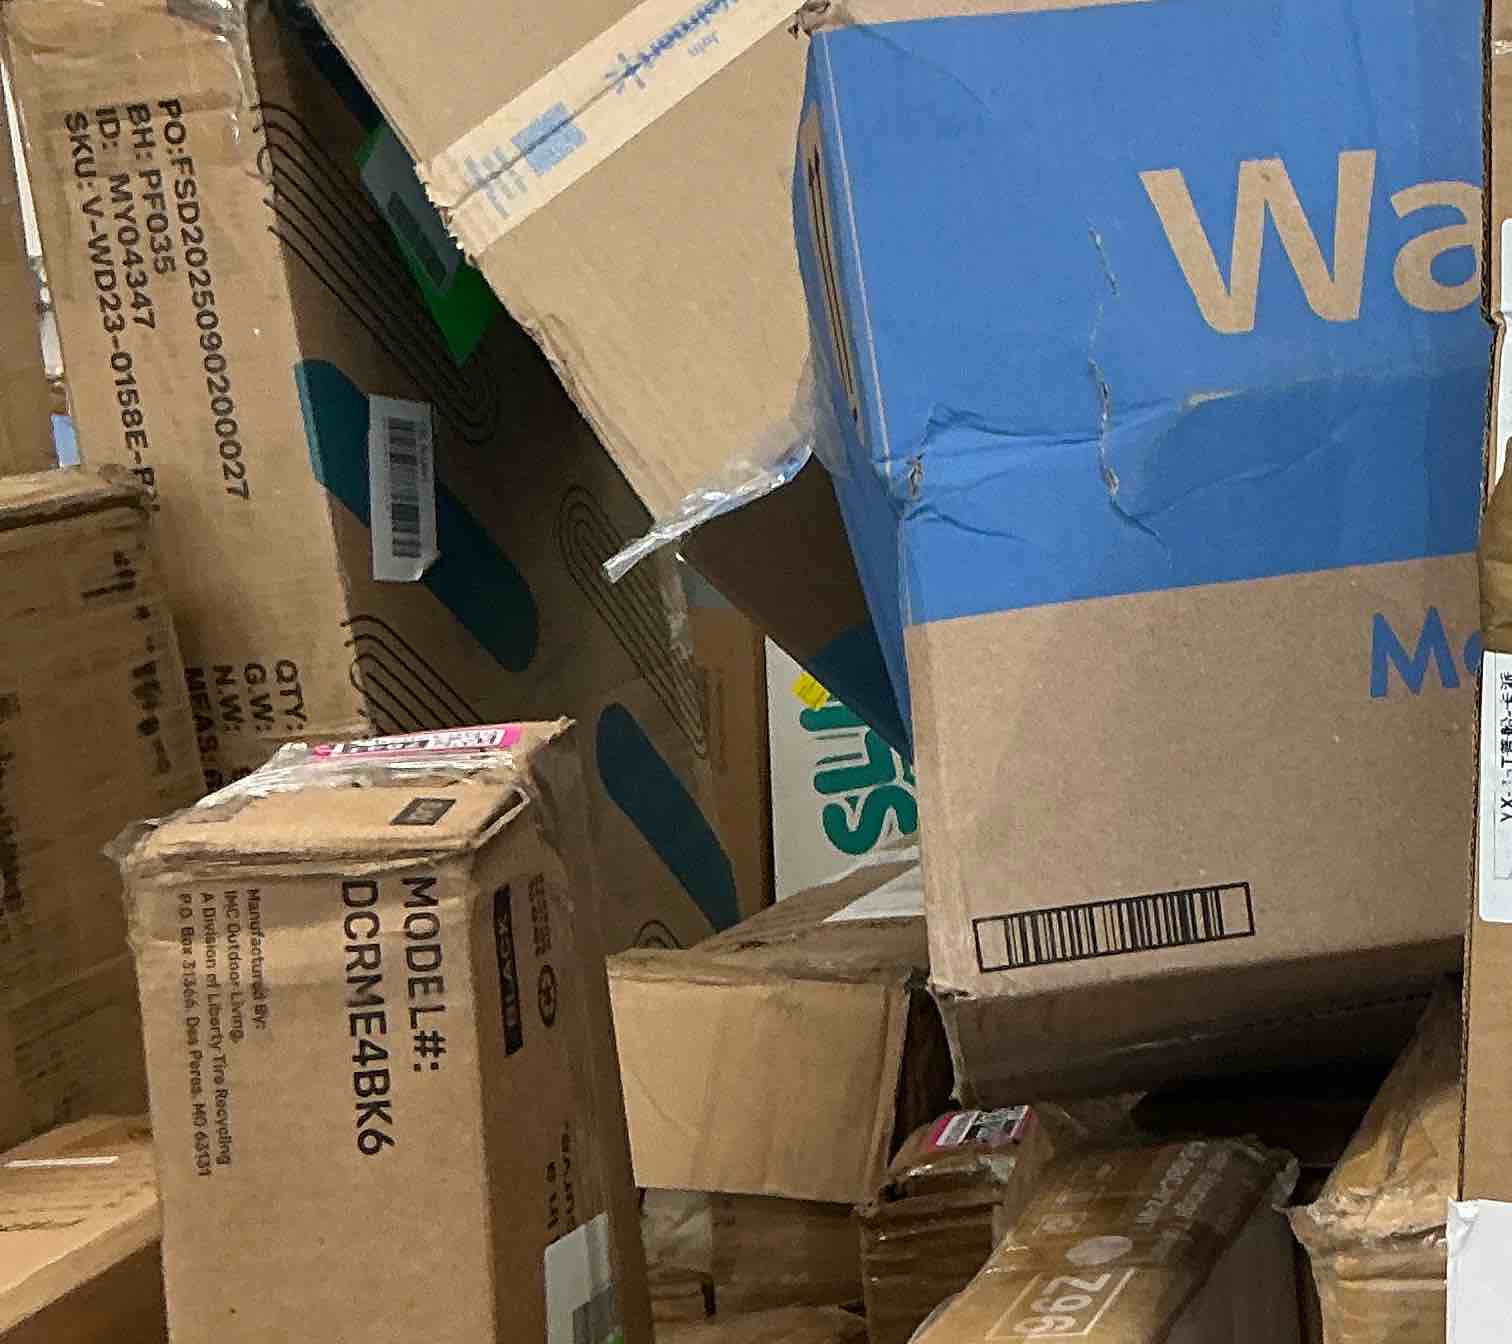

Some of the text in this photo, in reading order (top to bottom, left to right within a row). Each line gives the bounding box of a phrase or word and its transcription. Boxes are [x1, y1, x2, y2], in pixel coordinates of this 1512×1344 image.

[64, 111, 98, 190] SKU:
[341, 879, 395, 1157] DCRME4BK6
[401, 875, 448, 1074] MODEL#:
